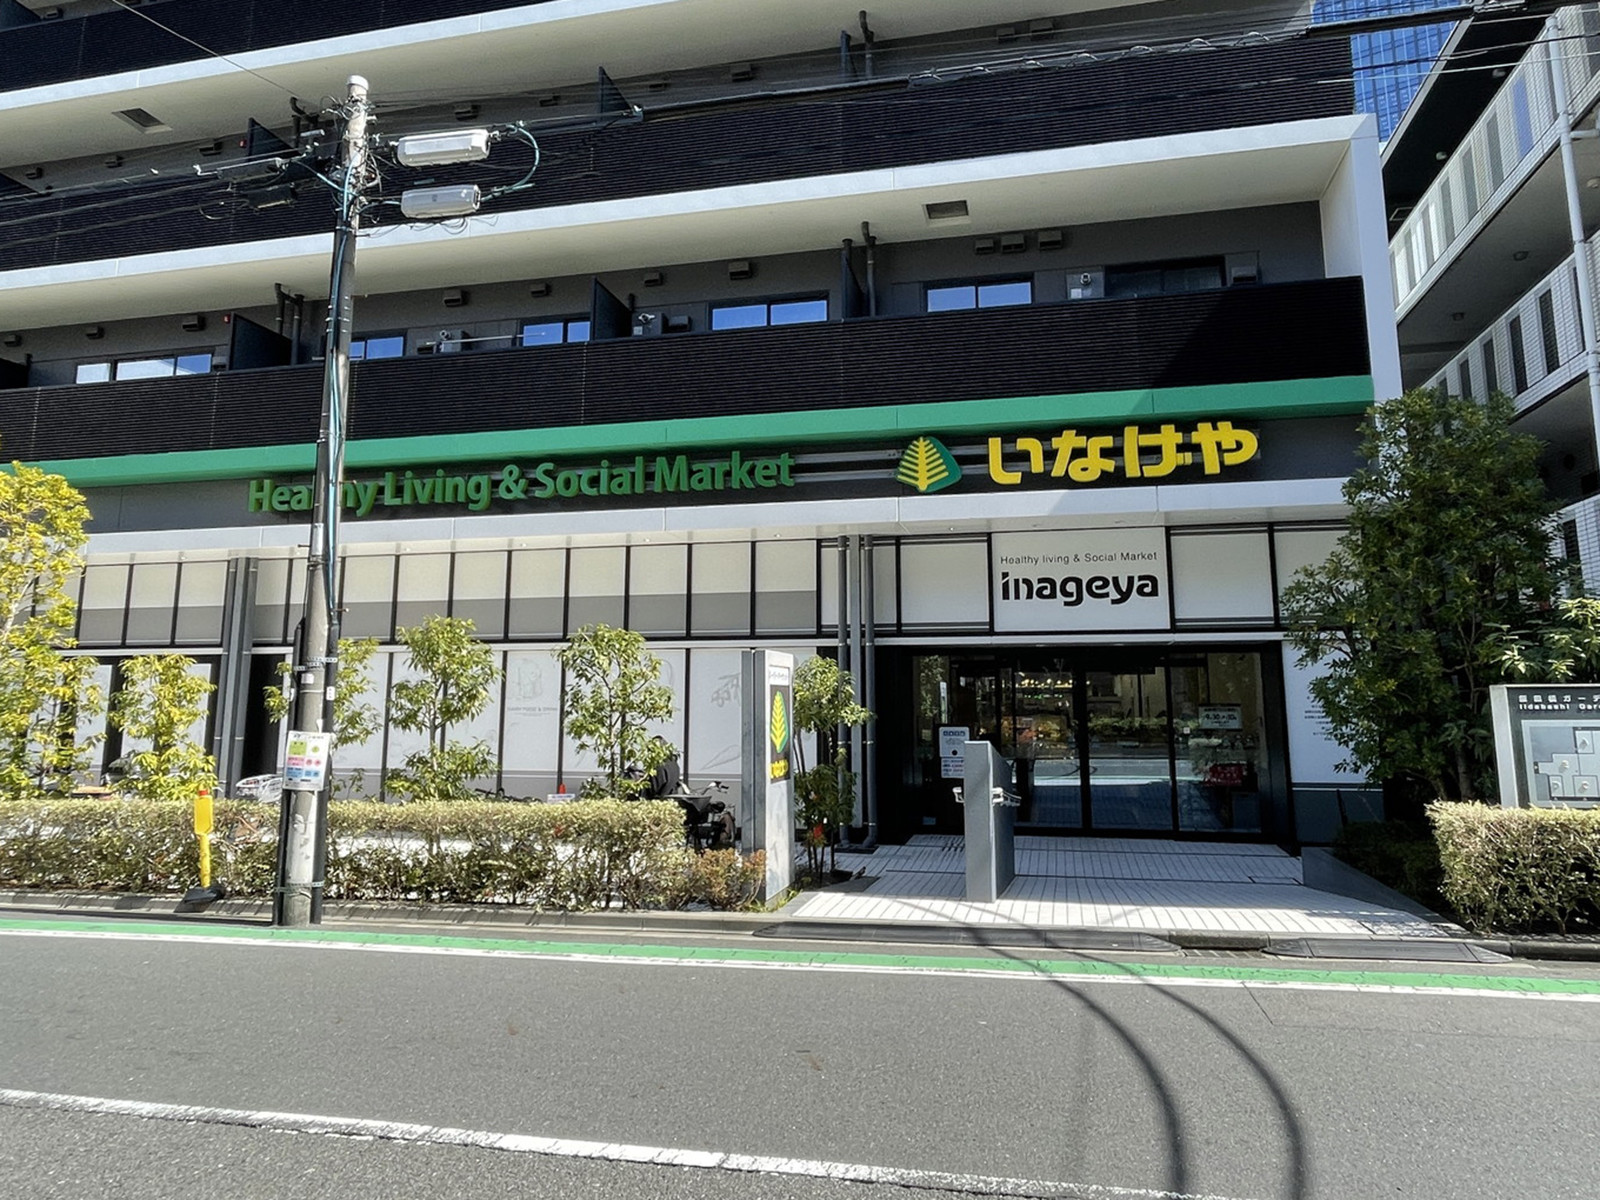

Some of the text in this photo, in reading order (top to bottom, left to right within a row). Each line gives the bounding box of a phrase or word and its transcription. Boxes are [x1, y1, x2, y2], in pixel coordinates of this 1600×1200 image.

[988, 421, 1258, 485] いなげや
[384, 469, 491, 511] Living
[499, 464, 529, 499] &
[534, 456, 646, 498] Social
[653, 451, 795, 492] Market
[1000, 551, 1158, 566] Healthy living & Social Market
[1001, 571, 1159, 607] inageya
